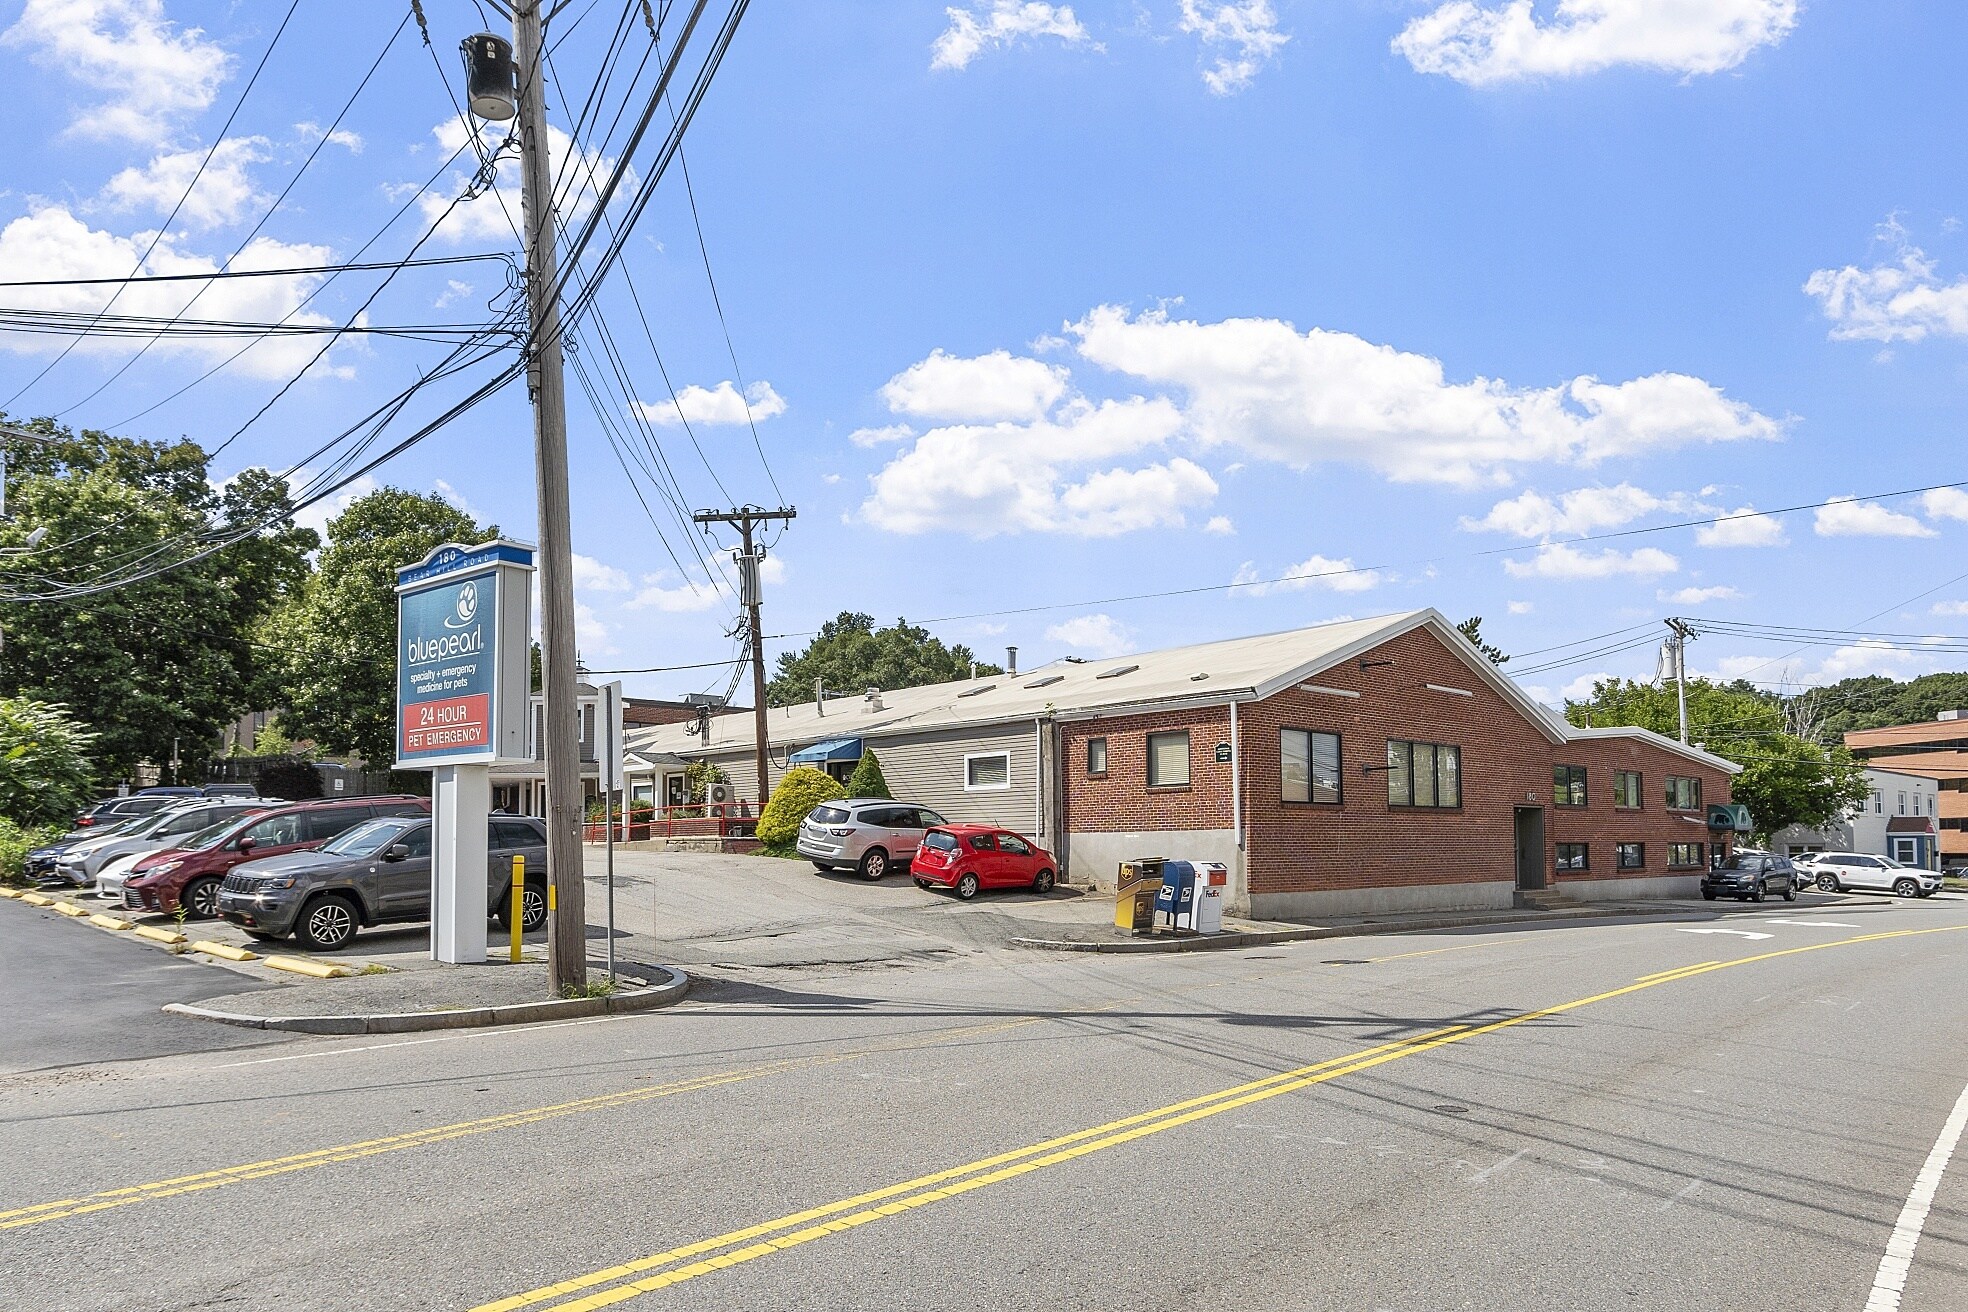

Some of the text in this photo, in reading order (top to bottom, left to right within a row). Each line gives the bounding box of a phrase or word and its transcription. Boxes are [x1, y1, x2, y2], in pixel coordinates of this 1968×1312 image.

[436, 564, 457, 575] HILL
[463, 553, 489, 568] ROAD
[439, 550, 456, 564] 180
[410, 670, 436, 685] specialty
[441, 663, 477, 677] emergency
[416, 677, 468, 694] medicine for pets
[420, 705, 467, 726] 24 HOUR
[408, 727, 481, 748] PET EMERGENCY
[1205, 889, 1220, 898] FedEx
